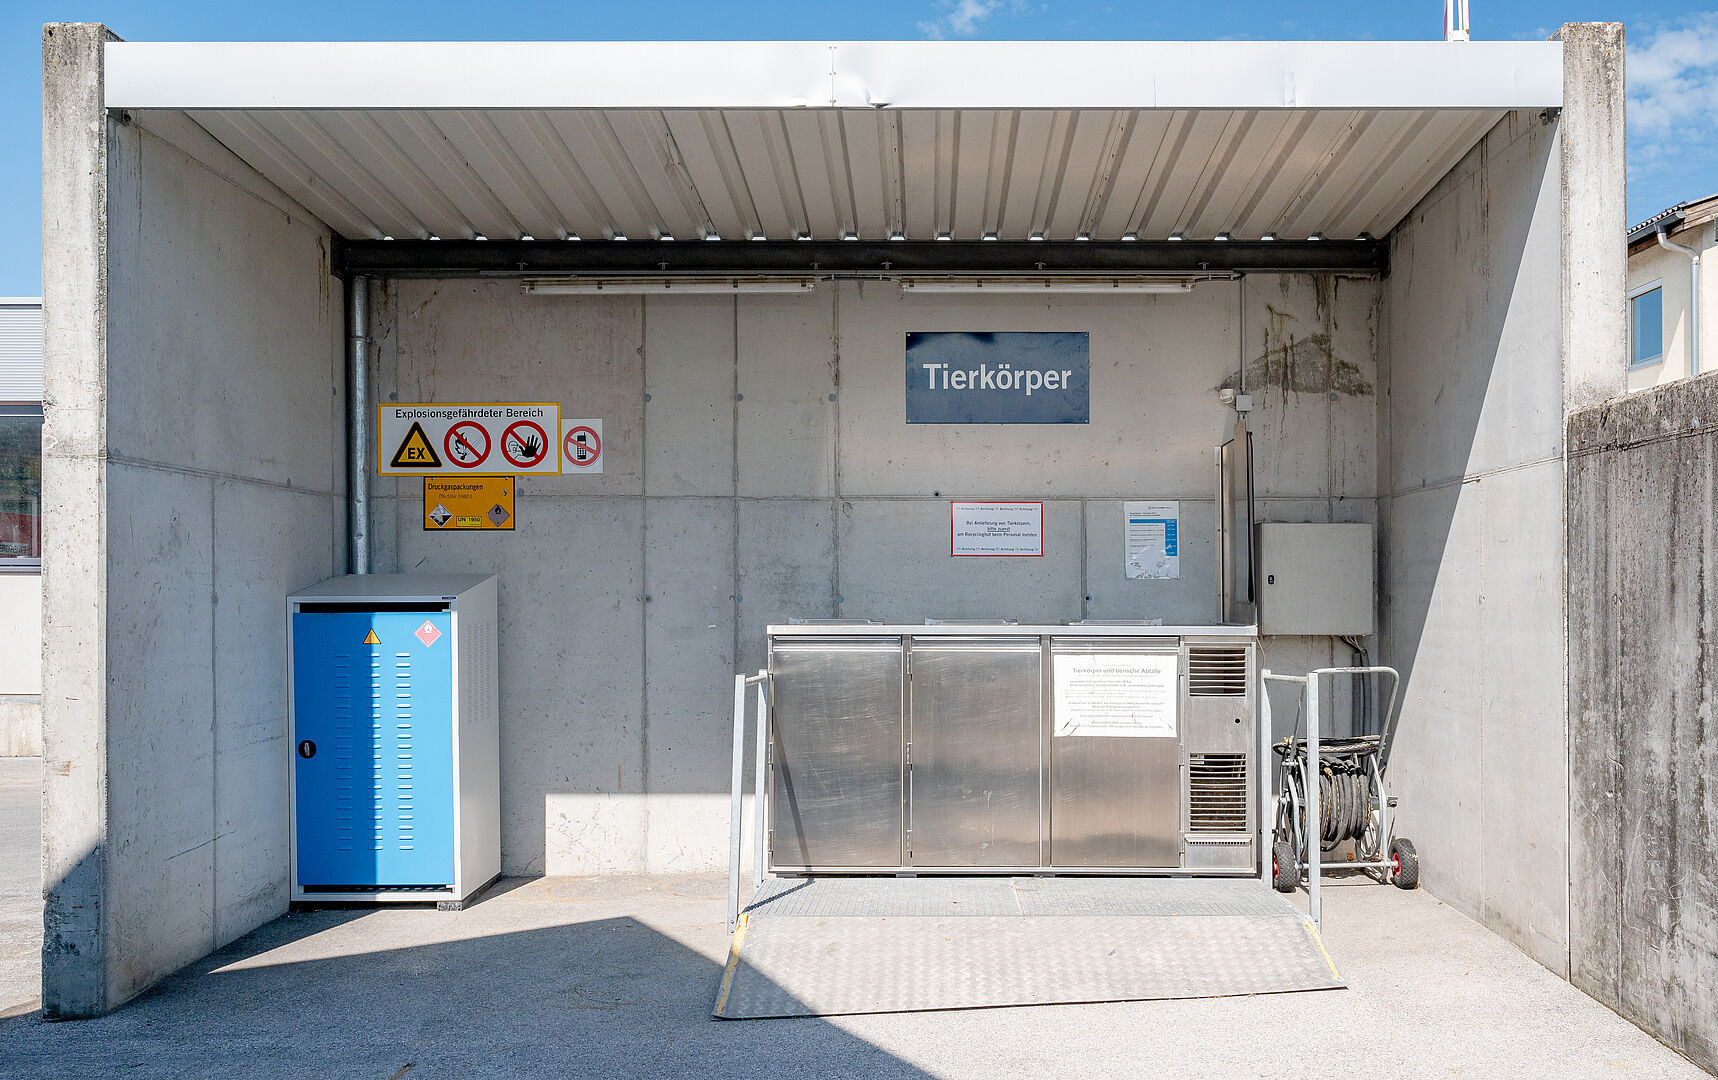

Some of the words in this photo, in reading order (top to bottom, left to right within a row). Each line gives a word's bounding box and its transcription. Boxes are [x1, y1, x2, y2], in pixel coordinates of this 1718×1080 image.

[922, 363, 1072, 396] Tierkörper
[396, 408, 502, 420] Explosionsgefährdeter
[506, 408, 544, 418] Bereich
[407, 447, 426, 460] EX
[428, 482, 484, 492] Druckgaspackungen
